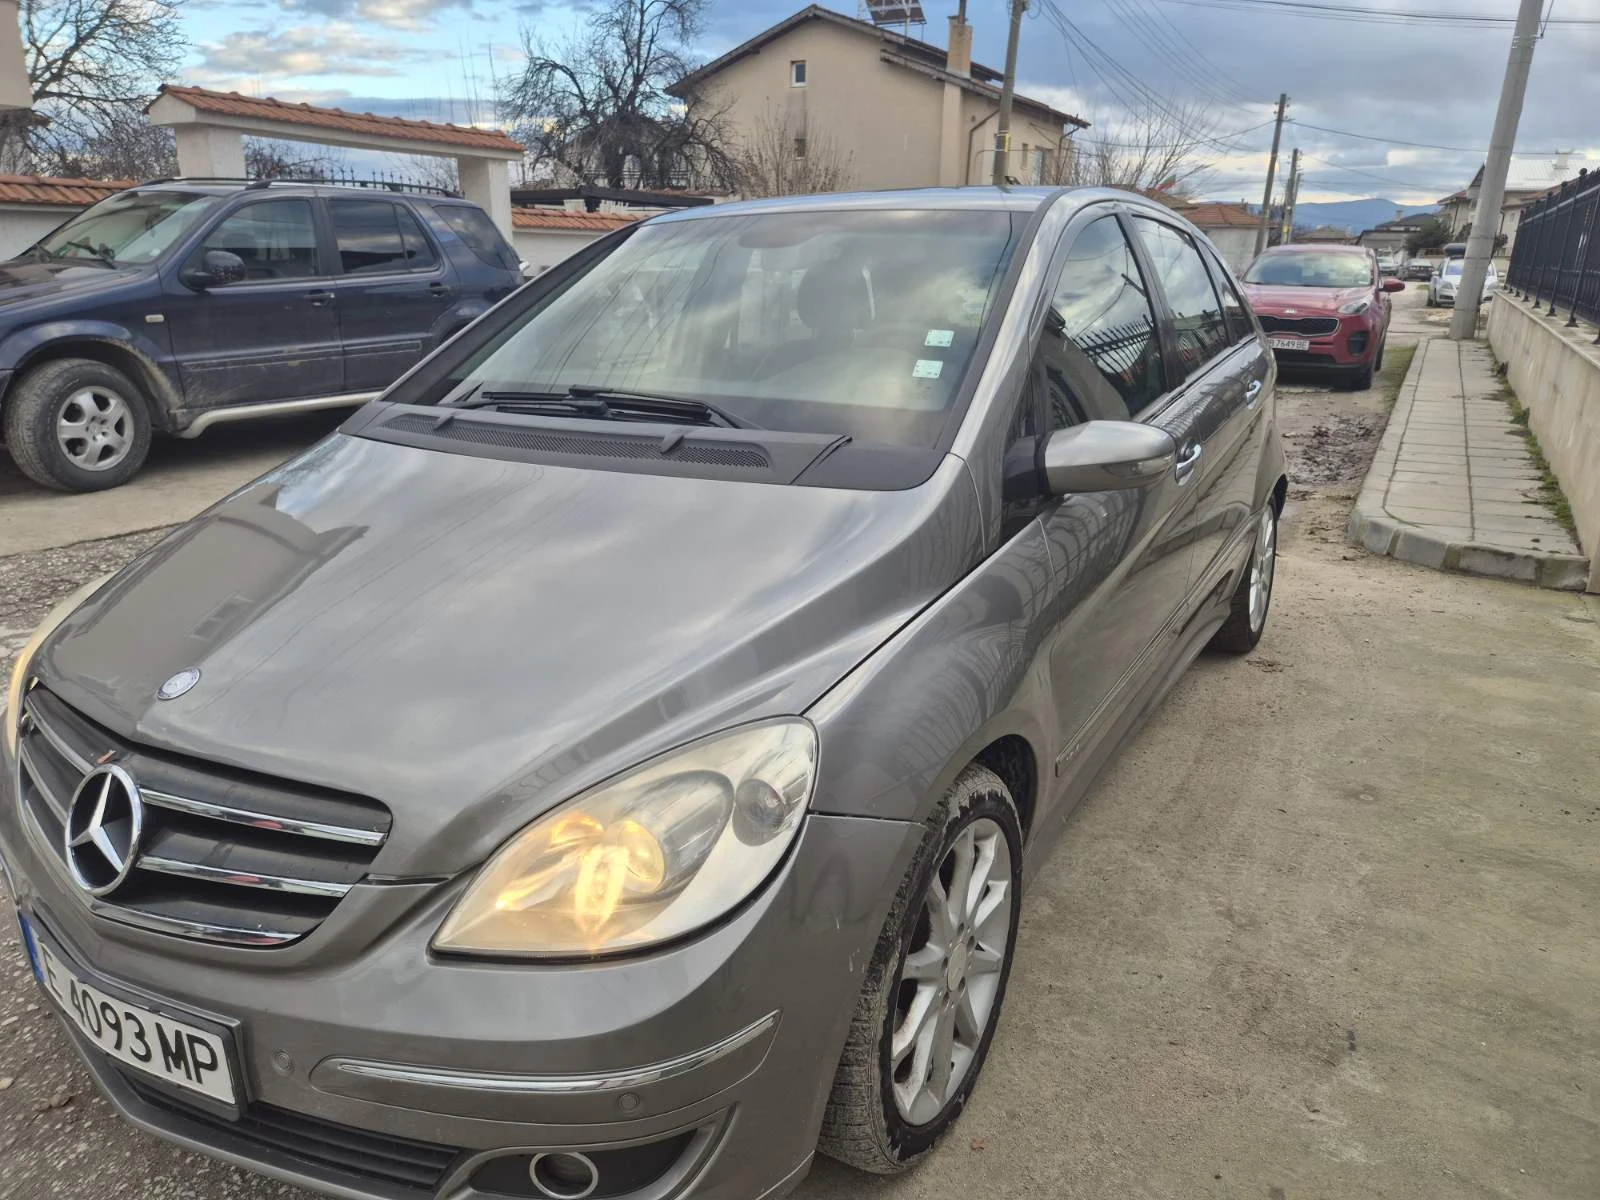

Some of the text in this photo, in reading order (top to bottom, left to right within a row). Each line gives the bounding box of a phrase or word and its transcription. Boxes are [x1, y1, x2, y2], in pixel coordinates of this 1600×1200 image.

[41, 945, 62, 999] E
[70, 979, 152, 1063] 4093
[155, 1021, 219, 1085] MP
